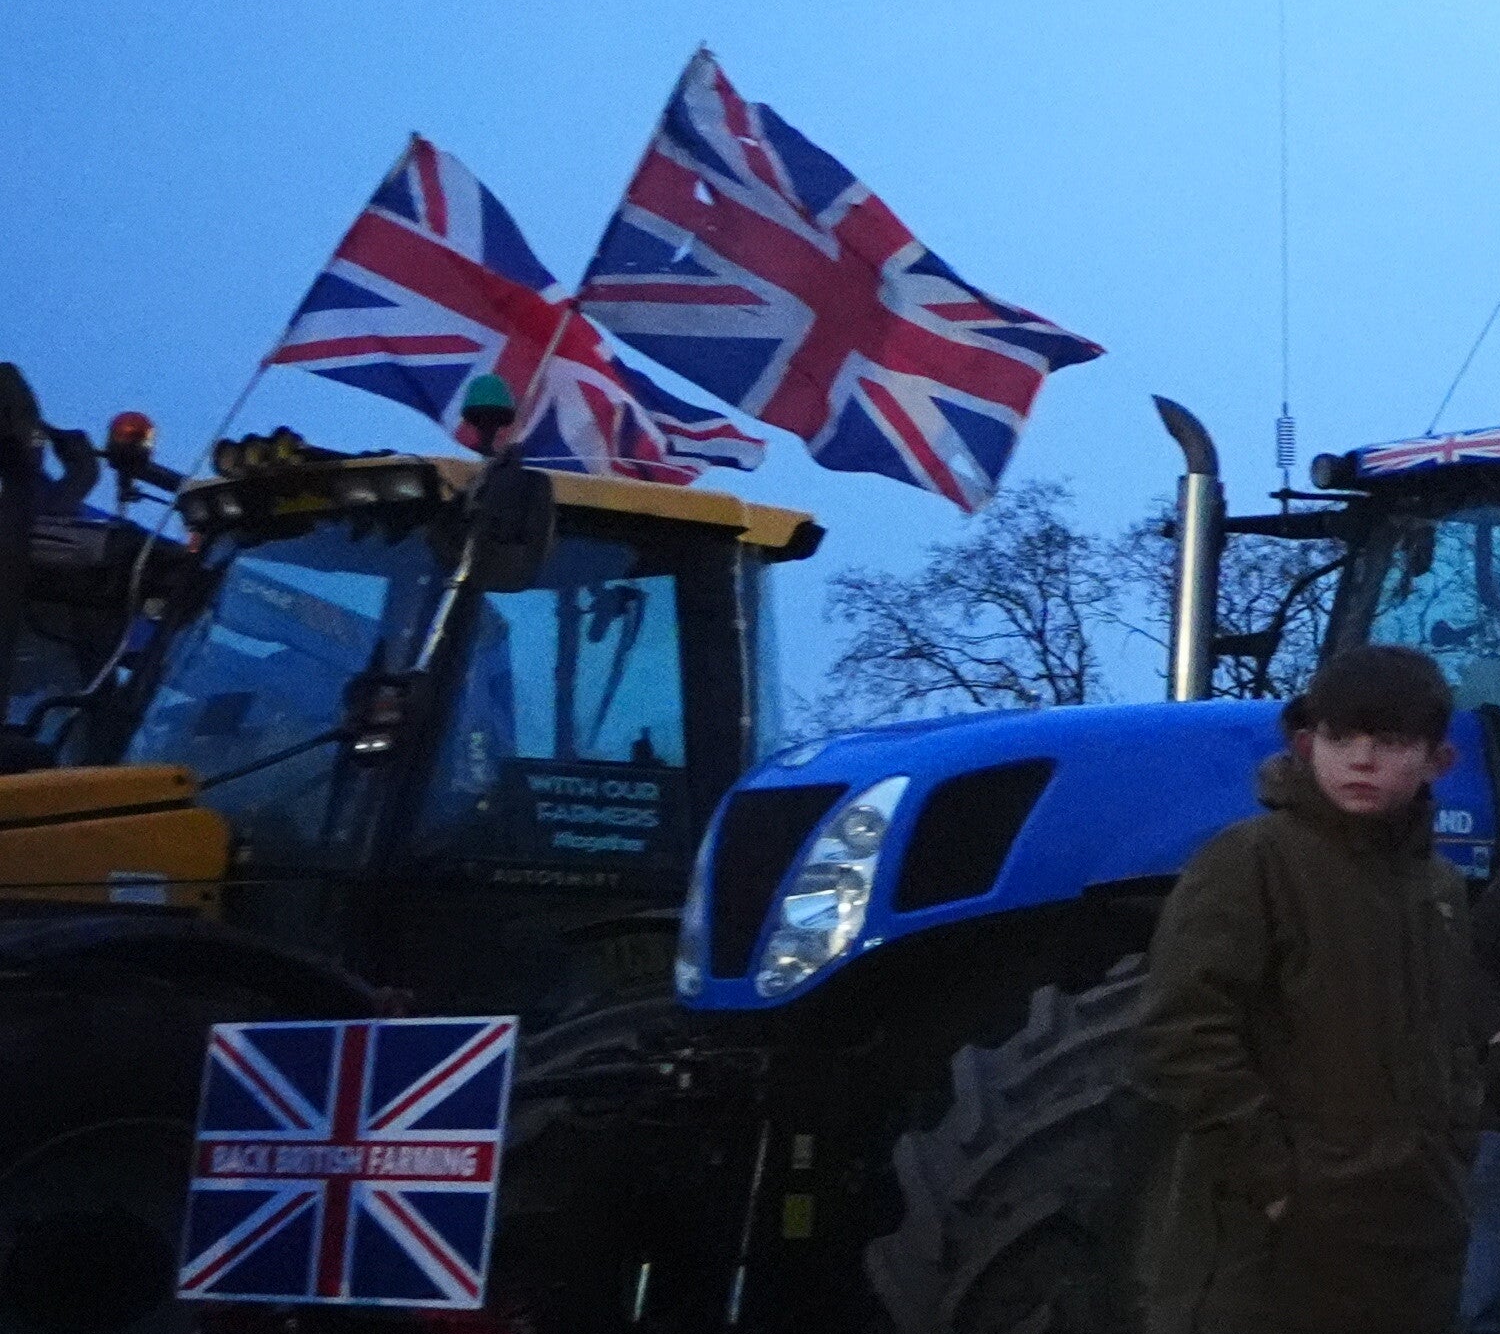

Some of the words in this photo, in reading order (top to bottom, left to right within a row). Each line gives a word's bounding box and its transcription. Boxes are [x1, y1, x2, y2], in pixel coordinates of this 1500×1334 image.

[526, 774, 598, 797] WITH
[600, 780, 661, 801] OUR
[535, 801, 660, 827] FARMERS
[211, 1144, 269, 1175] BACK
[274, 1144, 363, 1175] BRITISH
[366, 1145, 479, 1177] FARMING
